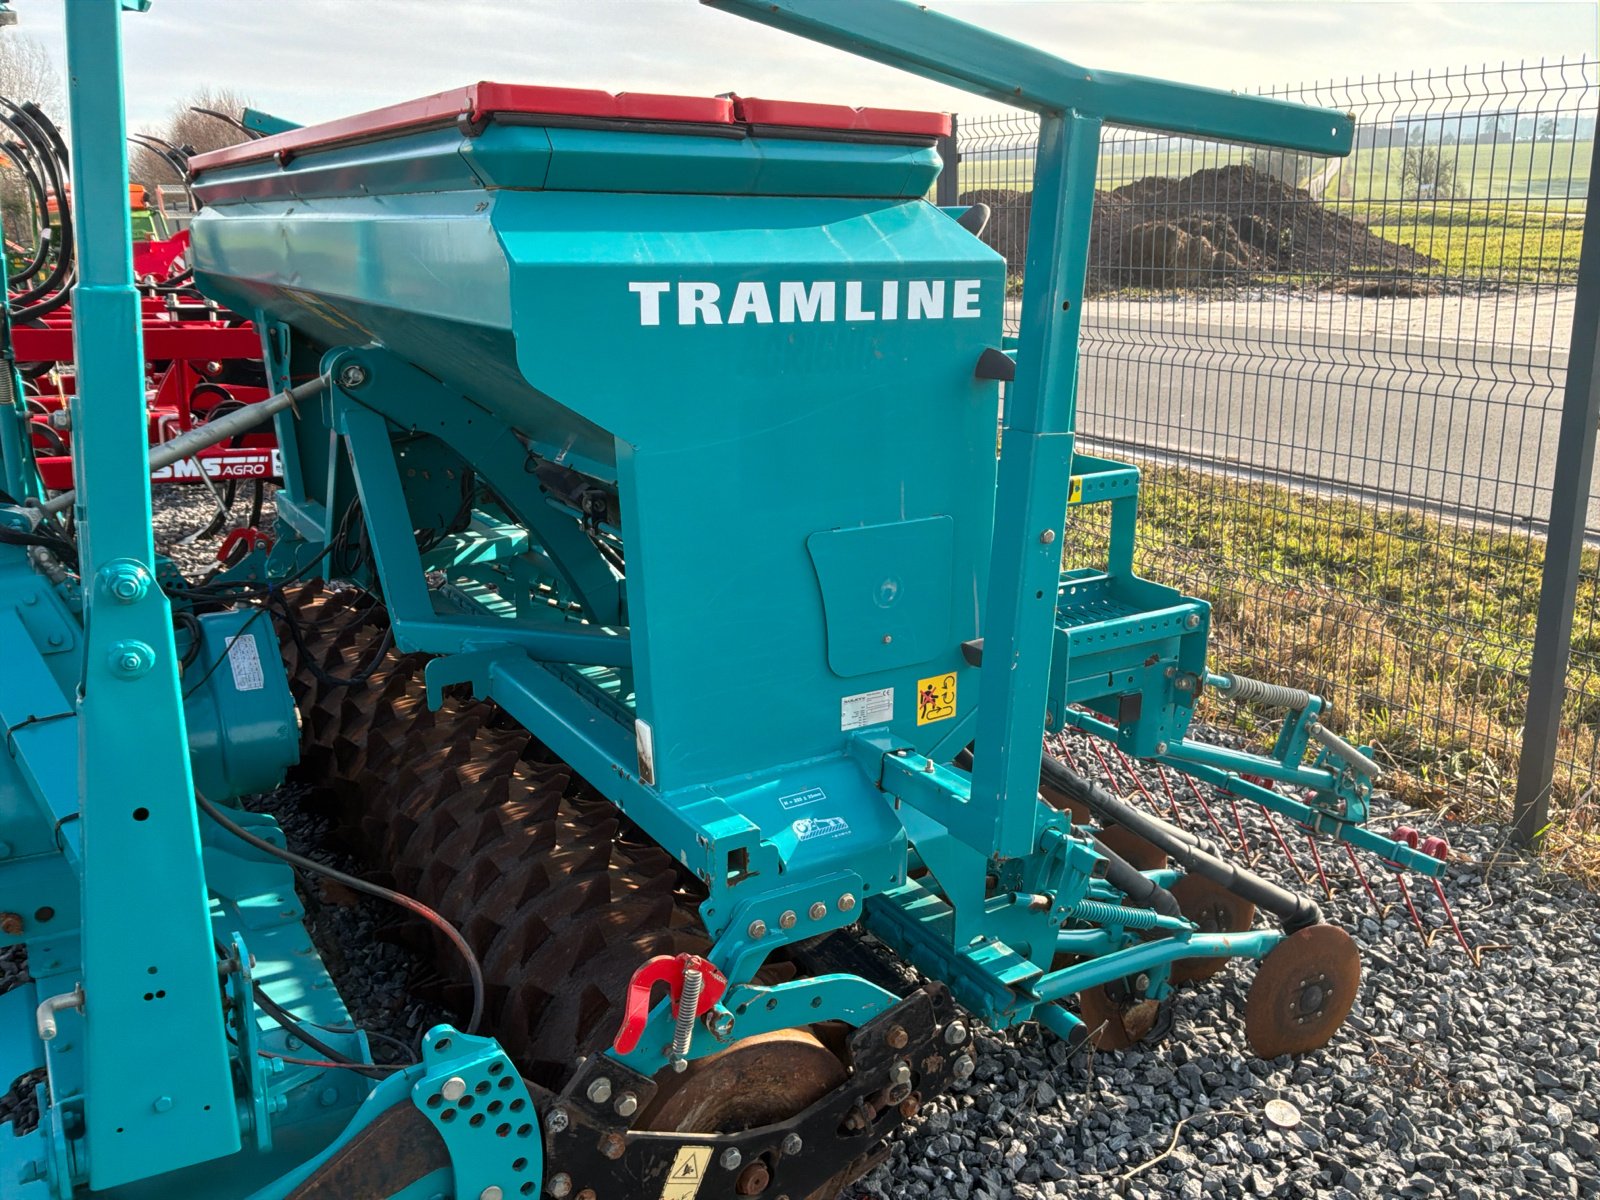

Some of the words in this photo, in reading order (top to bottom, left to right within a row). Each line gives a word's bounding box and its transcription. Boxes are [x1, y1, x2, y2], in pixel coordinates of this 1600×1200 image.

[629, 279, 981, 326] TRAMLINE
[151, 457, 221, 479] SMS
[222, 464, 265, 476] AGRO
